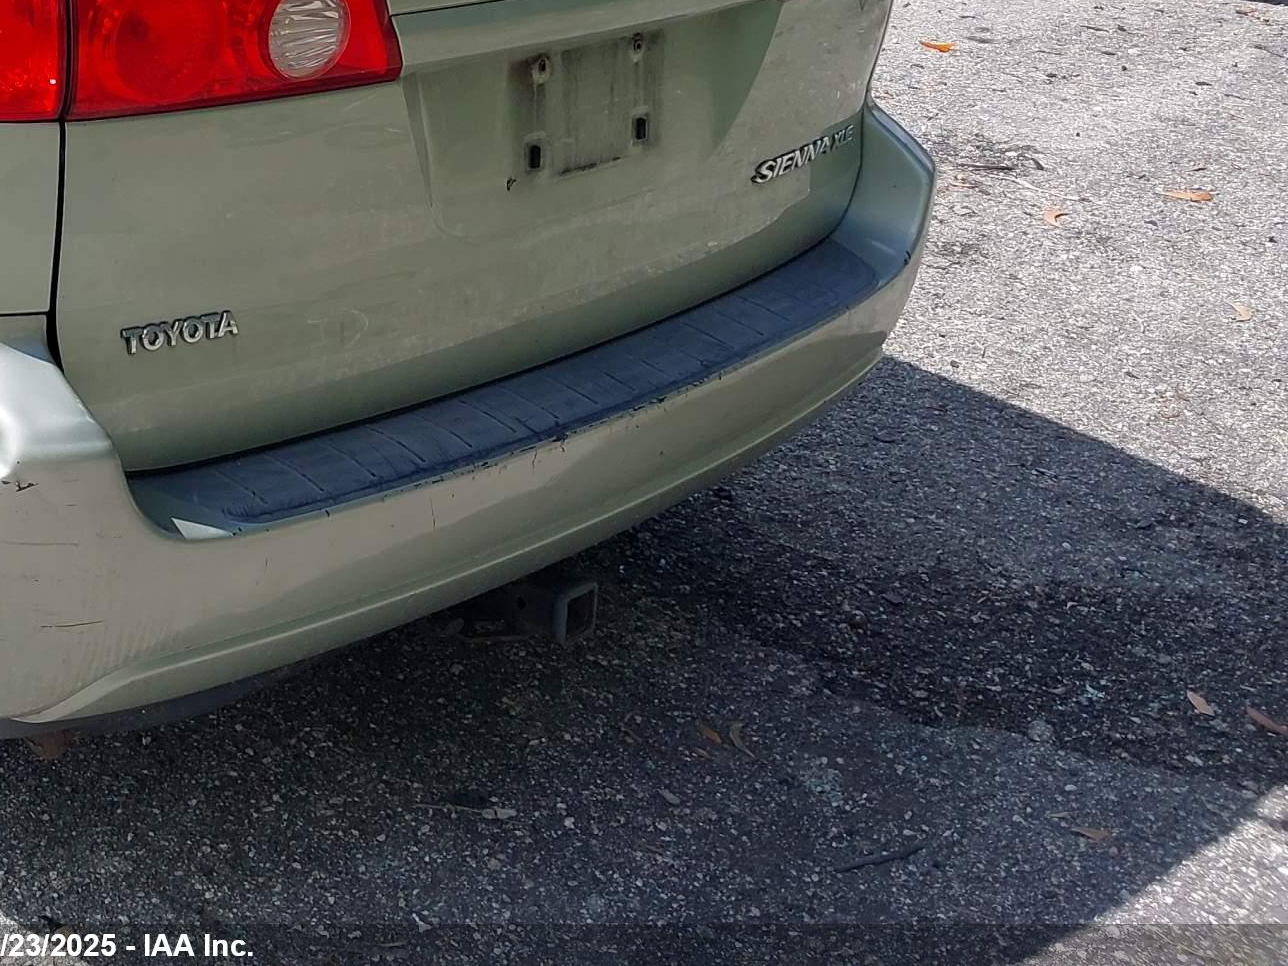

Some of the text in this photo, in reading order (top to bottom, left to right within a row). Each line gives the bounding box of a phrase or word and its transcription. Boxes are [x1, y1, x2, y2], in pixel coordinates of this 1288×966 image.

[750, 124, 855, 185] SIENNA XLE
[120, 309, 240, 355] TOYOTA
